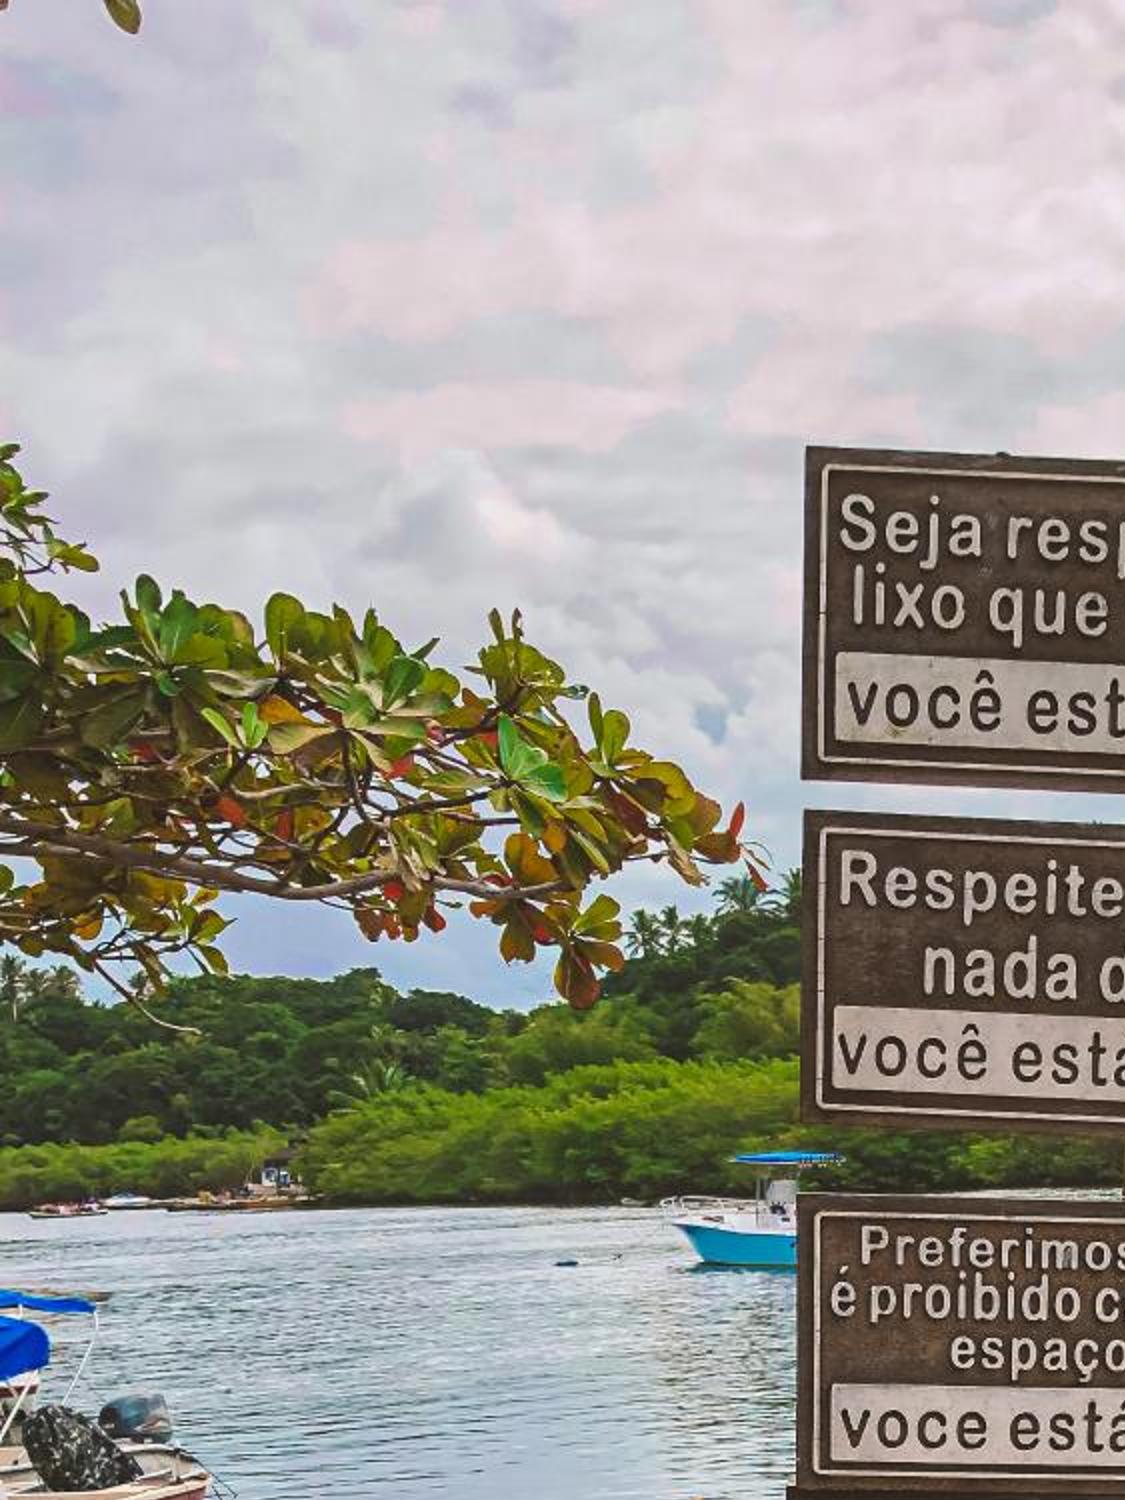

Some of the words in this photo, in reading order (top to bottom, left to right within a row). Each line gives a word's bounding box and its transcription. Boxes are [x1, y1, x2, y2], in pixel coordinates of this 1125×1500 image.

[840, 494, 981, 573] Seja
[854, 562, 965, 628] lixo
[990, 588, 1107, 648] que
[848, 670, 1001, 732] você
[840, 850, 1123, 925] Respeite
[924, 935, 1076, 1000] nada
[838, 1024, 986, 1080] você
[831, 1266, 856, 1316] é
[871, 1271, 1080, 1322] proibido
[841, 1408, 986, 1449] voce
